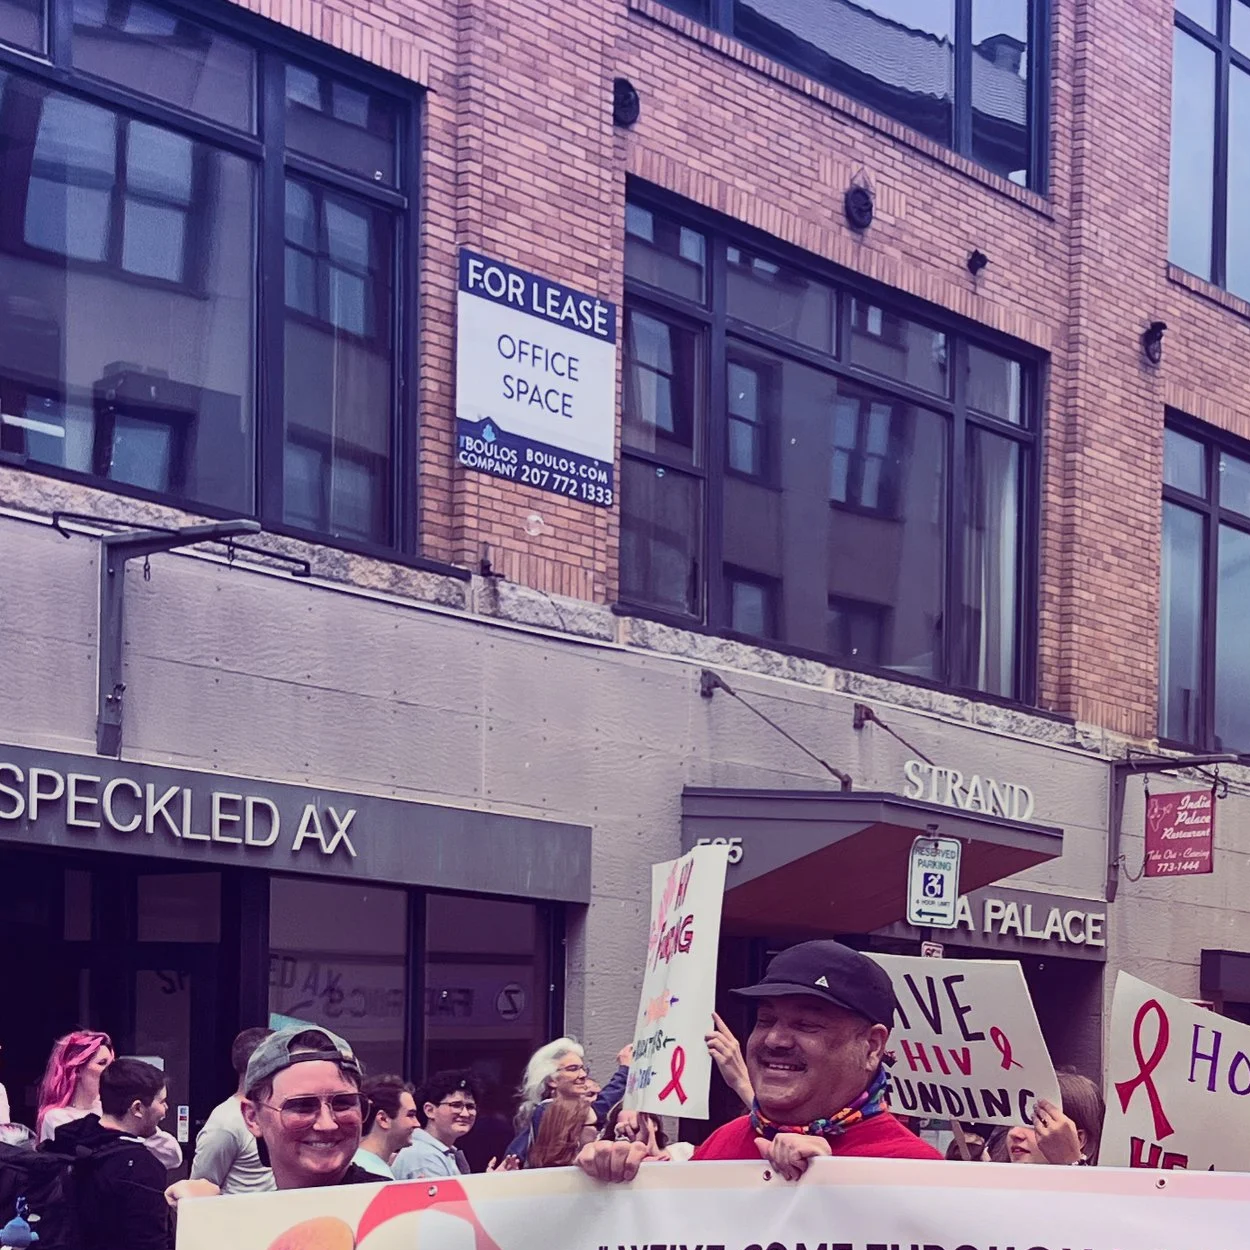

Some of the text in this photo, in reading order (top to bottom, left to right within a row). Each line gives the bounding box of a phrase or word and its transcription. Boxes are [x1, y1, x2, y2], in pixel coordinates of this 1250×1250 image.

[468, 258, 609, 337] FOR LEASE
[497, 334, 579, 383] OFFICE
[502, 374, 573, 419] SPACE
[459, 452, 518, 478] COMPANY
[465, 436, 518, 464] BOULOS
[526, 448, 608, 484] BOULOS.COM
[521, 465, 613, 506] 207 772 1333
[903, 759, 1035, 821] STRAND
[1177, 794, 1211, 810] India
[0, 761, 357, 858] SPECKLED AX
[1174, 810, 1211, 826] Palace
[1161, 827, 1210, 840] Restaurant
[914, 847, 956, 860] RESERVED
[917, 858, 952, 872] PARKING
[983, 897, 1106, 948] PALACE
[900, 1039, 972, 1076] HIV
